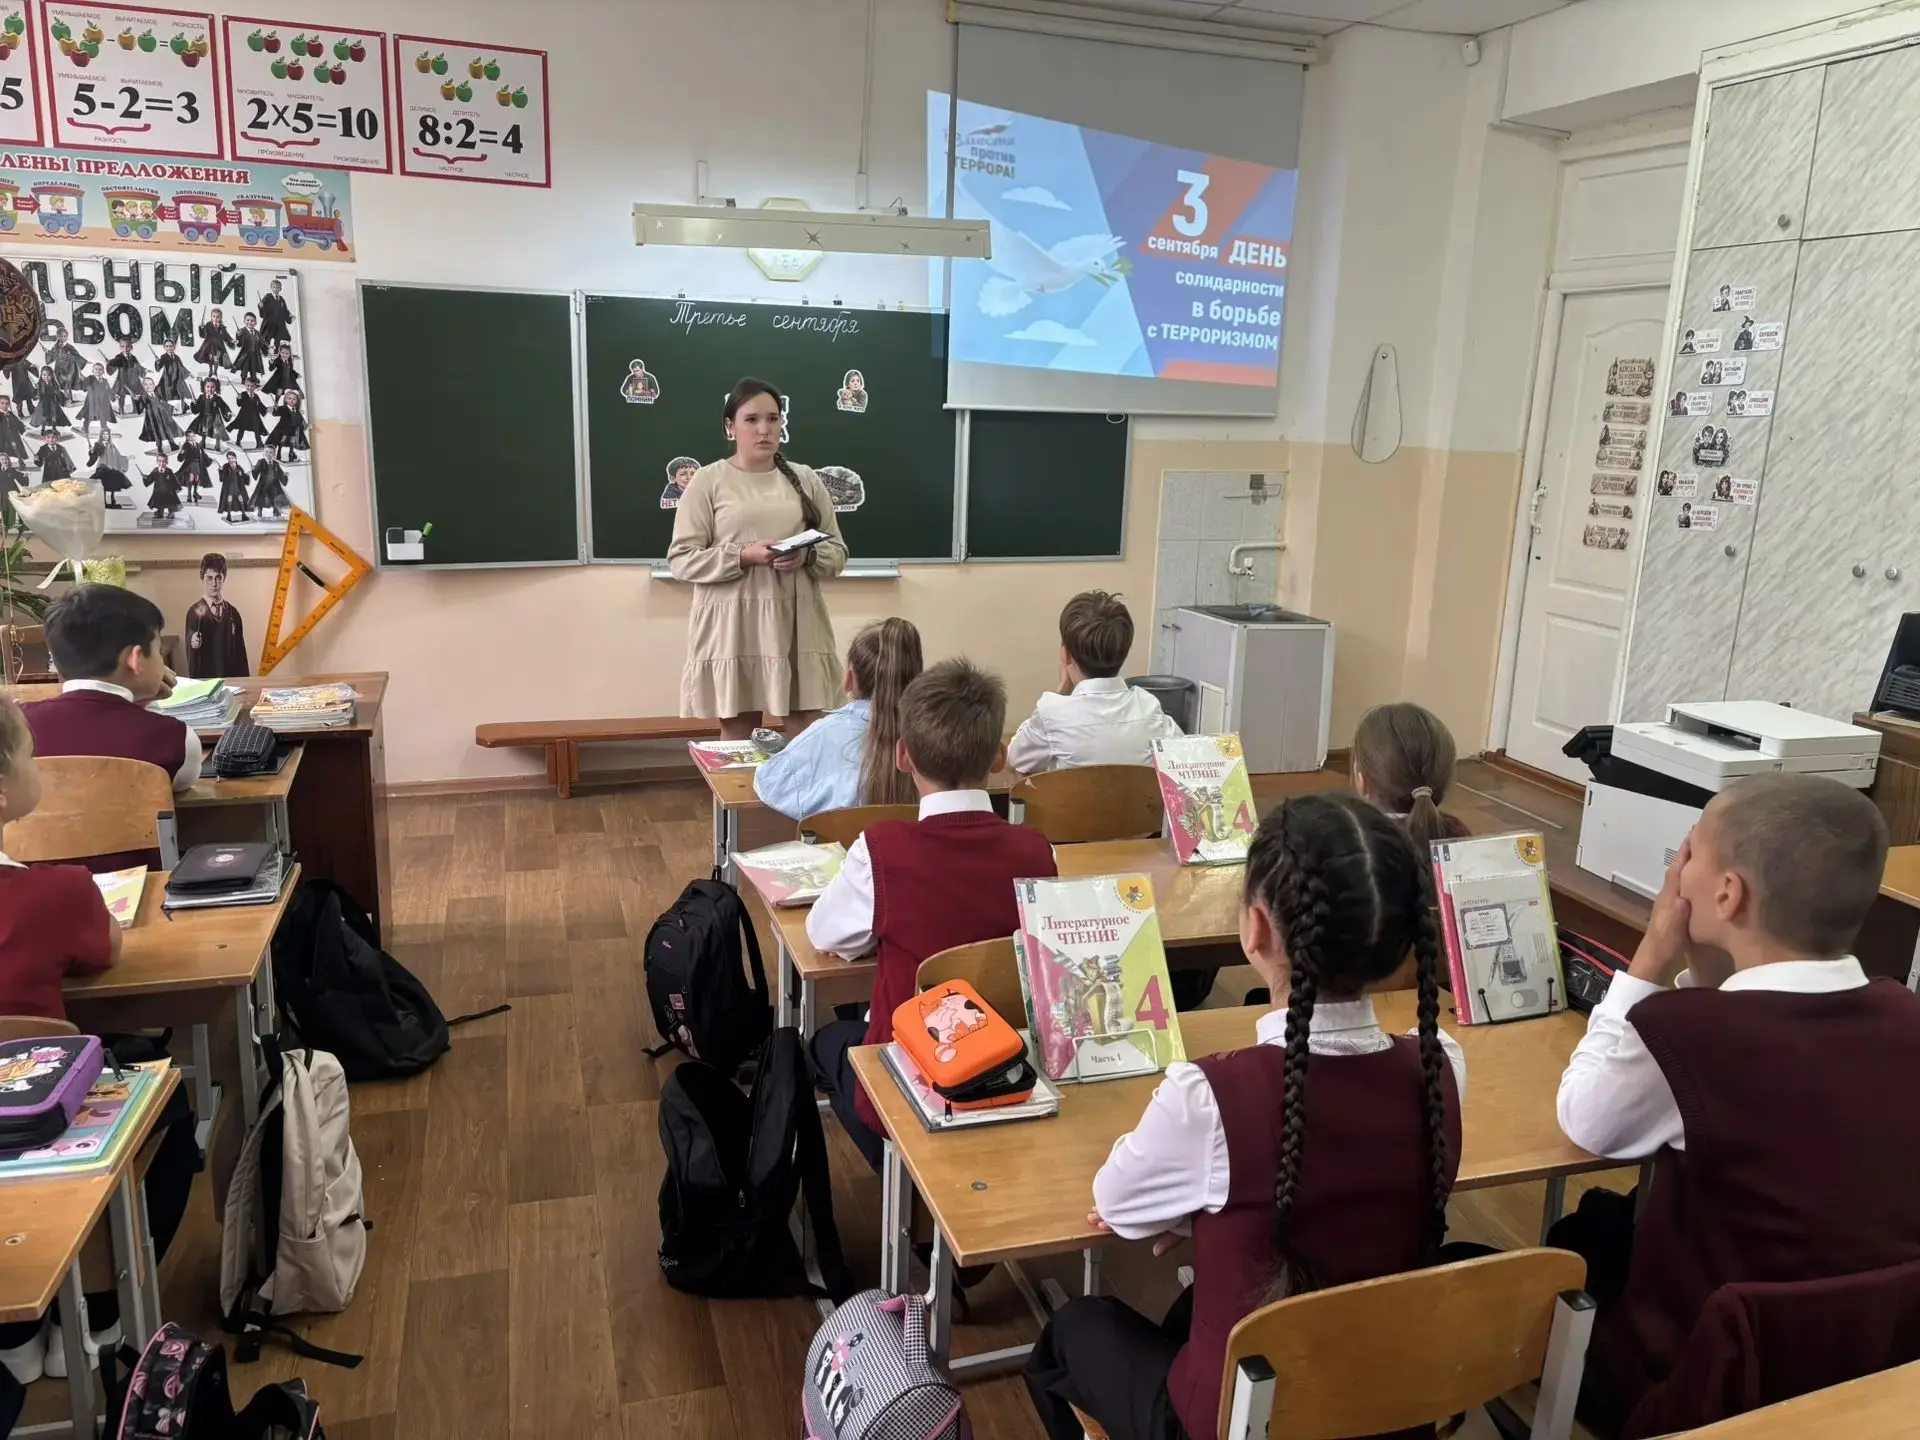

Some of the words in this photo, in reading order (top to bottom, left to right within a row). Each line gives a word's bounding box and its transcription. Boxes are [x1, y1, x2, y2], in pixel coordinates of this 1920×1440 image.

[970, 146, 1016, 164] против
[76, 158, 250, 185] ПРЕДЛОЖЕНИЯ
[1172, 169, 1210, 237] 3
[1147, 236, 1219, 260] сентября
[1228, 239, 1287, 269] ДЕНЬ
[1175, 271, 1285, 298] солидарности
[669, 301, 747, 336] Третье
[772, 310, 861, 343] сентября
[1191, 301, 1205, 318] в
[1209, 298, 1281, 327] борьбе
[1147, 324, 1158, 338] с
[1160, 323, 1279, 351] ТЕРРОРИЗМОМ
[661, 499, 678, 508] НЕТ
[1168, 758, 1227, 770] Литературное
[1178, 769, 1221, 779] ЧТЕНИЕ
[1041, 914, 1130, 932] Литературное
[1056, 929, 1120, 945] ЧТЕНИЕ
[1135, 974, 1170, 1031] 4
[1090, 1054, 1116, 1063] Часть
